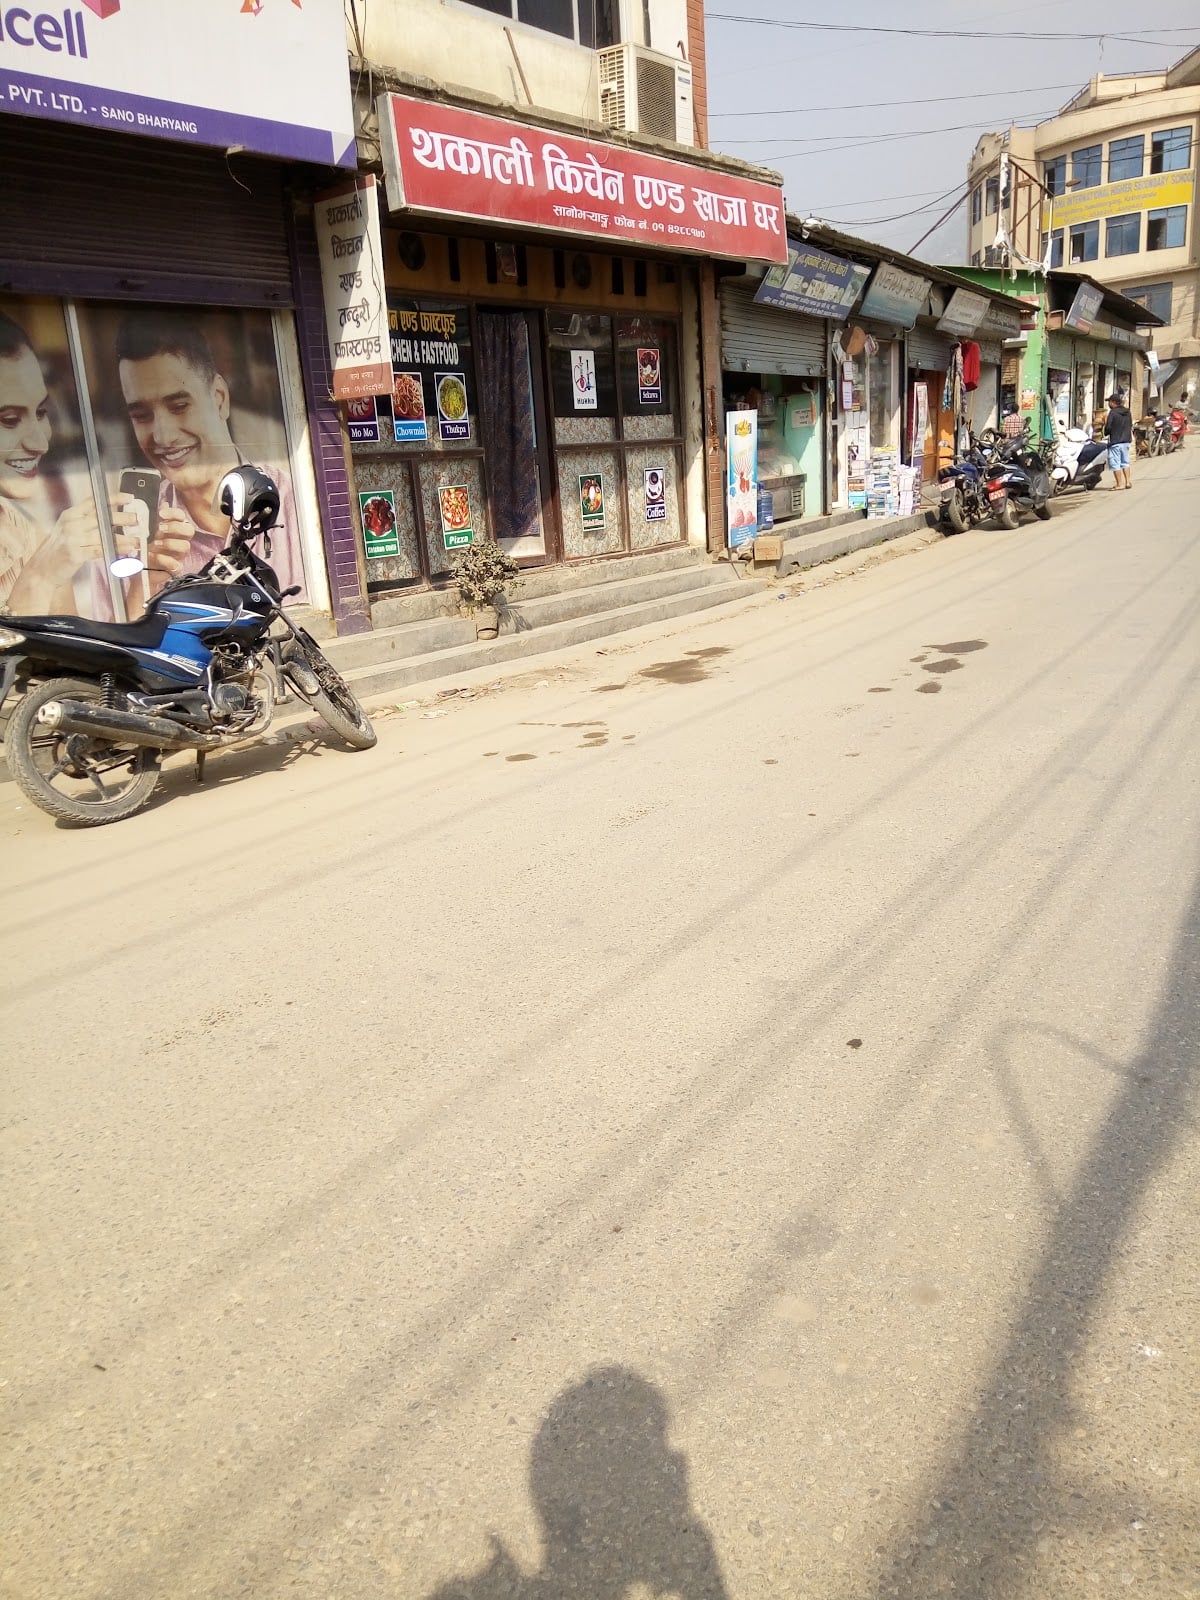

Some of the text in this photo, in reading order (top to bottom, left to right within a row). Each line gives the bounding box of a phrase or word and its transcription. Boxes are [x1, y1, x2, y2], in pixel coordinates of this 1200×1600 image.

[0, 8, 88, 59] cell
[8, 84, 47, 107] PVT.
[51, 92, 88, 115] LTD.
[101, 105, 135, 123] SANO
[137, 114, 198, 134] BHARYANG
[409, 127, 780, 235] थकाली किचेन एण्ड खाजा घर
[326, 194, 363, 226] थकाली
[614, 214, 636, 229] फोन
[652, 222, 665, 232] ०१
[331, 235, 363, 260] किचन
[413, 340, 421, 363] &
[421, 340, 459, 365] FASTFOOD
[351, 426, 374, 437] Mo Mo
[396, 425, 426, 437] Chowmin
[445, 424, 467, 438] Thukpa
[646, 508, 665, 519] Coffee
[449, 535, 469, 545] Pizza
